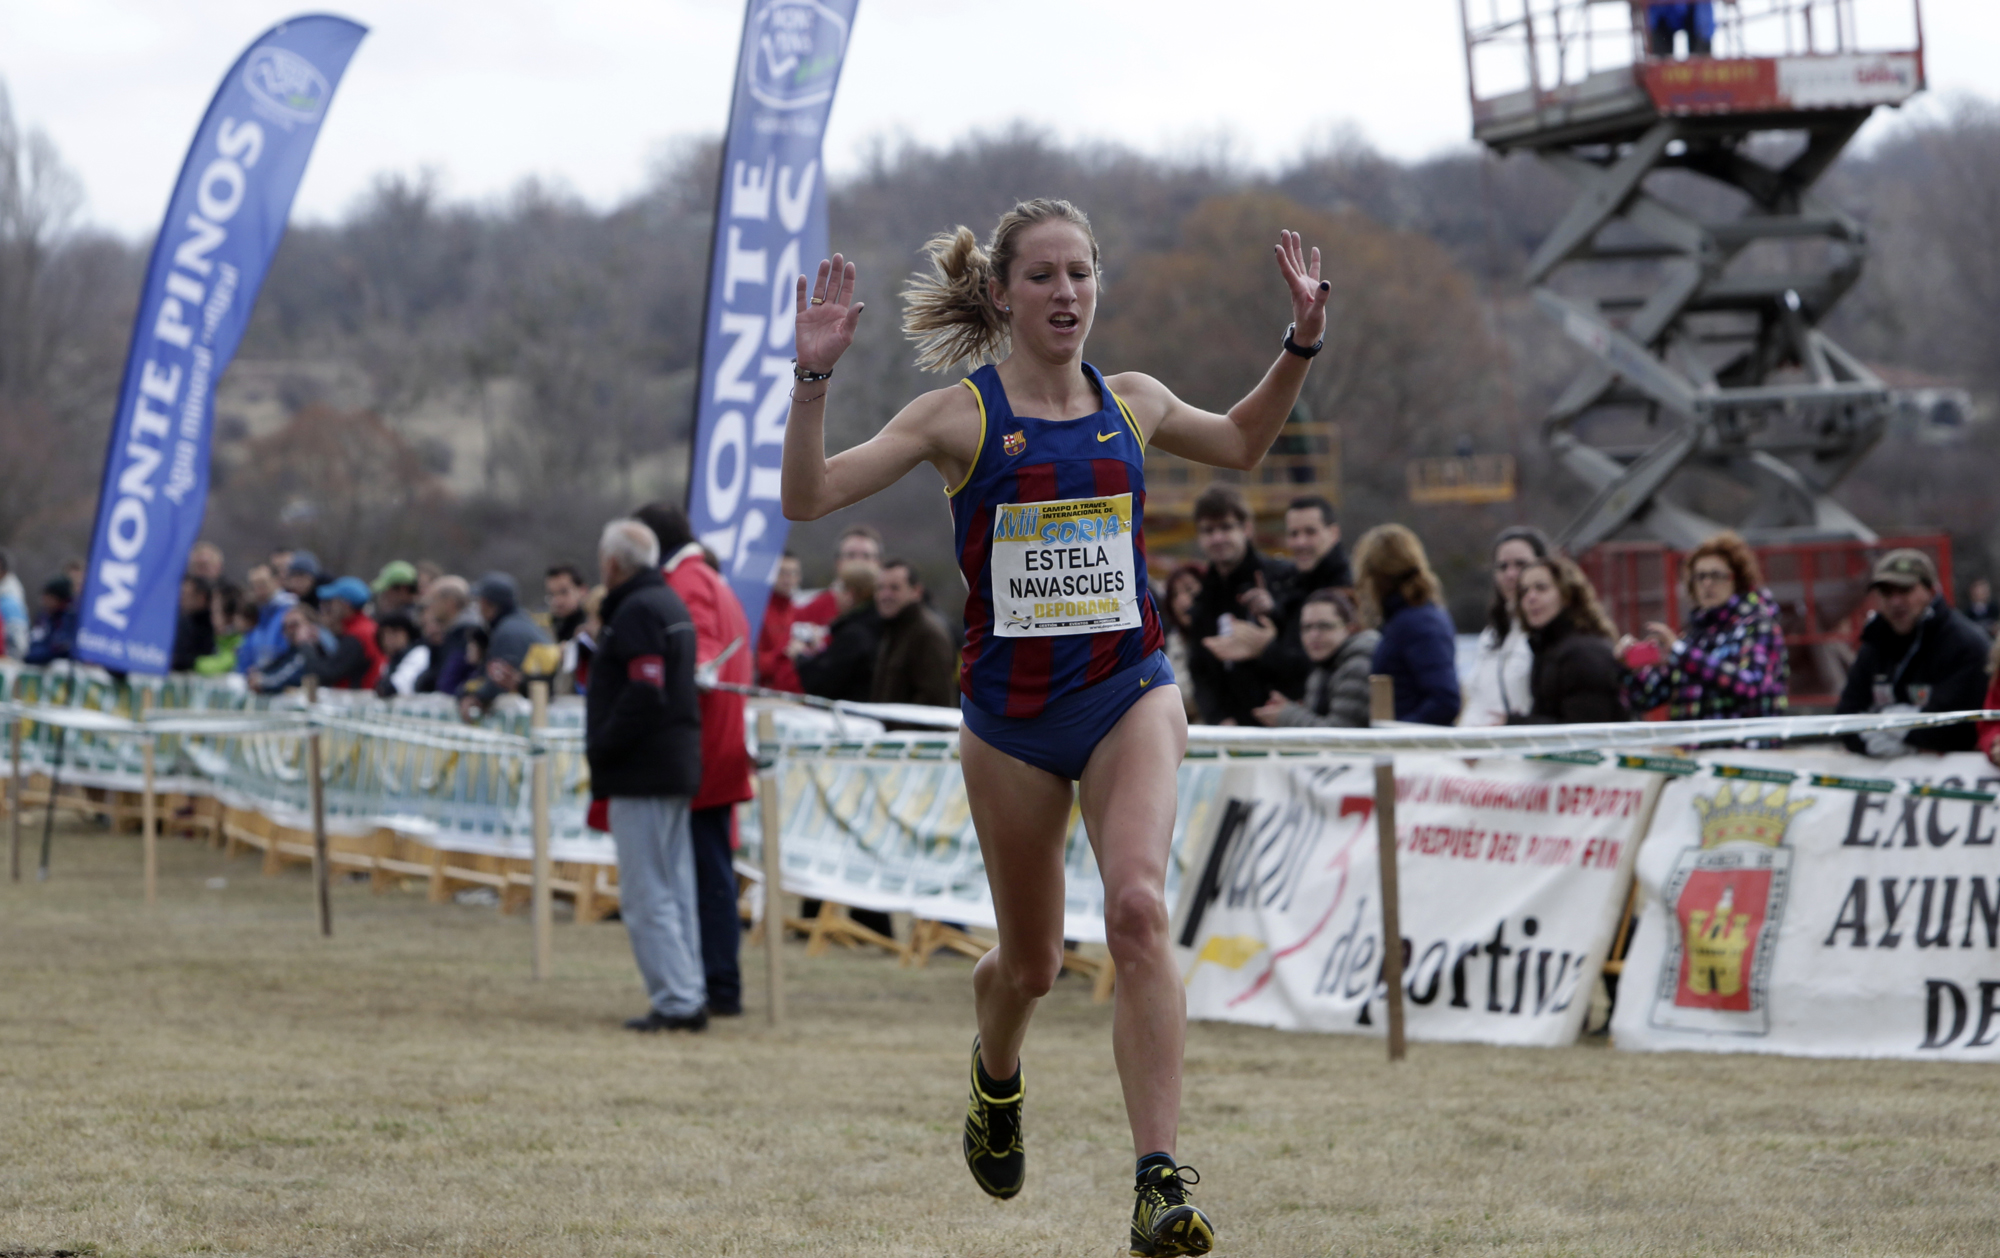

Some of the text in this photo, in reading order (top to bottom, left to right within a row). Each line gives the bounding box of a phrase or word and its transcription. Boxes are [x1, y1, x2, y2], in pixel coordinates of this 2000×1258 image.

[93, 359, 183, 631] MONTE
[151, 115, 265, 351] PINOS
[1042, 504, 1071, 513] CAMPO
[1072, 503, 1078, 511] A
[1042, 508, 1102, 519] INTERNACIONAL
[994, 507, 1039, 539] XVIII
[1040, 514, 1121, 546] SORIA
[1025, 545, 1109, 572] ESTELA
[1009, 570, 1125, 599] NAVASCUES
[1034, 597, 1121, 618] DEPORAMA
